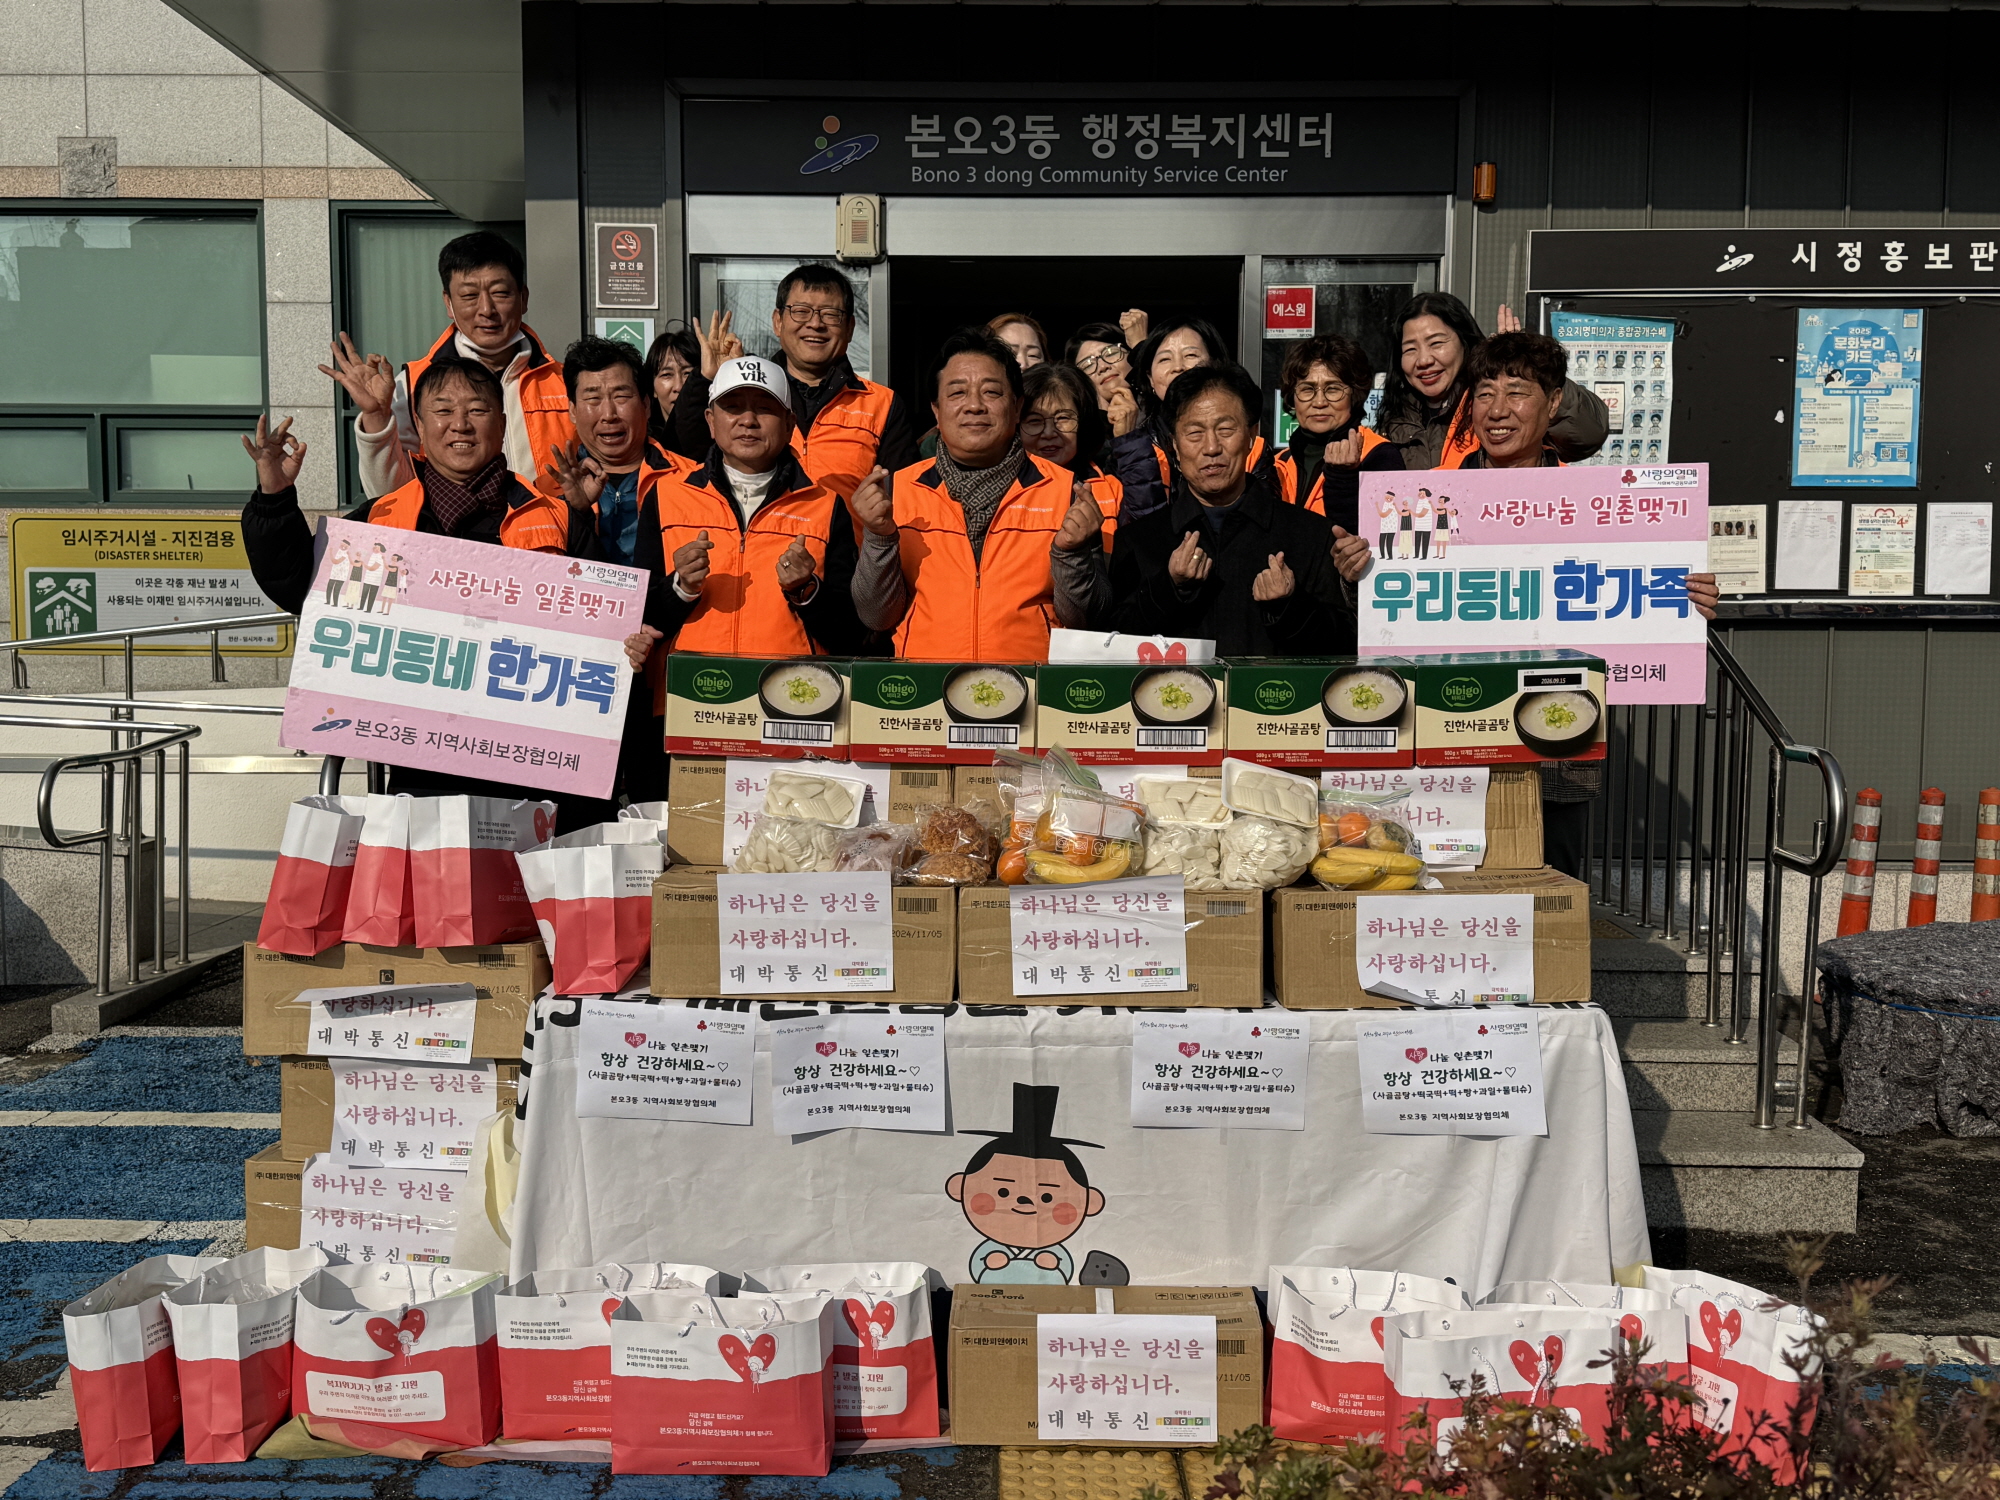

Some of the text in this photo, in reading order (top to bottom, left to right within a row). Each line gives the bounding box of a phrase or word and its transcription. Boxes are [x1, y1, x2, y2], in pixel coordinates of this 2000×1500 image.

[904, 112, 1334, 161] 본오3동 행정복지센터
[911, 165, 1288, 188] Bono 3 dong Community Service Center
[1272, 303, 1306, 317] 에스원
[1557, 326, 1667, 338] 중요지명피의자 종합공개수배
[1849, 327, 1872, 335] 2025
[1834, 336, 1886, 350] 문화누리
[1846, 350, 1873, 363] 카드
[736, 361, 761, 372] Vol
[740, 370, 768, 385] vik
[1640, 469, 1698, 481] 사랑의열매
[1478, 494, 1689, 527] 사랑나눔 일촌맺기
[61, 529, 157, 547] 임시주거시설
[171, 530, 236, 548] 지진겸용
[94, 550, 204, 563] (DISASTER SHELTER)
[585, 565, 639, 583] 사랑의열매
[135, 578, 240, 589] 이곳은 각종 재난 발생 시
[1371, 556, 1692, 623] 우리동네 한가족
[107, 596, 265, 607] 사용되는 이재민 임시주거시설입니다.
[427, 568, 627, 619] 사랑나눔 일촌맺기
[308, 617, 620, 716] 우리동네 한가족
[696, 674, 731, 689] bibigo
[881, 681, 916, 696] bibigo
[1069, 685, 1103, 700] bibigo
[1258, 686, 1293, 701] bibigo
[1445, 685, 1480, 699] bibigo
[693, 710, 759, 727] 진한사골곰탕
[878, 716, 944, 732] 진한사골곰탕
[1443, 718, 1511, 733] 진한사골곰탕
[1067, 721, 1132, 736] 진한사골곰탕
[1256, 722, 1322, 737] 진한사골곰탕
[354, 718, 581, 772] 본오3동 지역사회보장협의체
[1330, 772, 1477, 794] 하나님은 당신을
[727, 892, 880, 915] 하나님은 당신을
[1020, 892, 1173, 915] 하나님은 당신을
[1366, 916, 1522, 939] 하나님은 당신을
[729, 928, 858, 951] 사랑하십니다.
[1020, 928, 1150, 951] 사랑하십니다.
[1365, 952, 1497, 975] 사랑하십니다.
[628, 1034, 709, 1053] 사랑 나눔 일촌맺기
[818, 1043, 899, 1058] 사랑 나눔 일촌맺기
[600, 1051, 629, 1068] 항상
[1181, 1044, 1263, 1060] 사랑 나눔 일촌맺기
[1408, 1049, 1493, 1063] 사랑 나눔 일촌맺기
[794, 1064, 822, 1080] 항상
[1154, 1062, 1183, 1078] 항상
[343, 1071, 486, 1094] 하나님은 당신을
[1383, 1070, 1413, 1087] 항상
[610, 1095, 717, 1108] 본오3동 지역사회보장협의체
[343, 1105, 464, 1128] 사랑하십니다.
[807, 1104, 911, 1116] 본오3동 지역사회보장협의체
[1164, 1105, 1271, 1115] 본오3동 지역사회보장협의체
[1399, 1110, 1510, 1121] 본오3동 지역사회보장협의체
[310, 1173, 455, 1203] 하나님은 당신을
[309, 1206, 430, 1235] 사랑하십니다.
[1046, 1337, 1205, 1360] 하나님은 당신을
[1046, 1373, 1181, 1396] 사랑하십니다.
